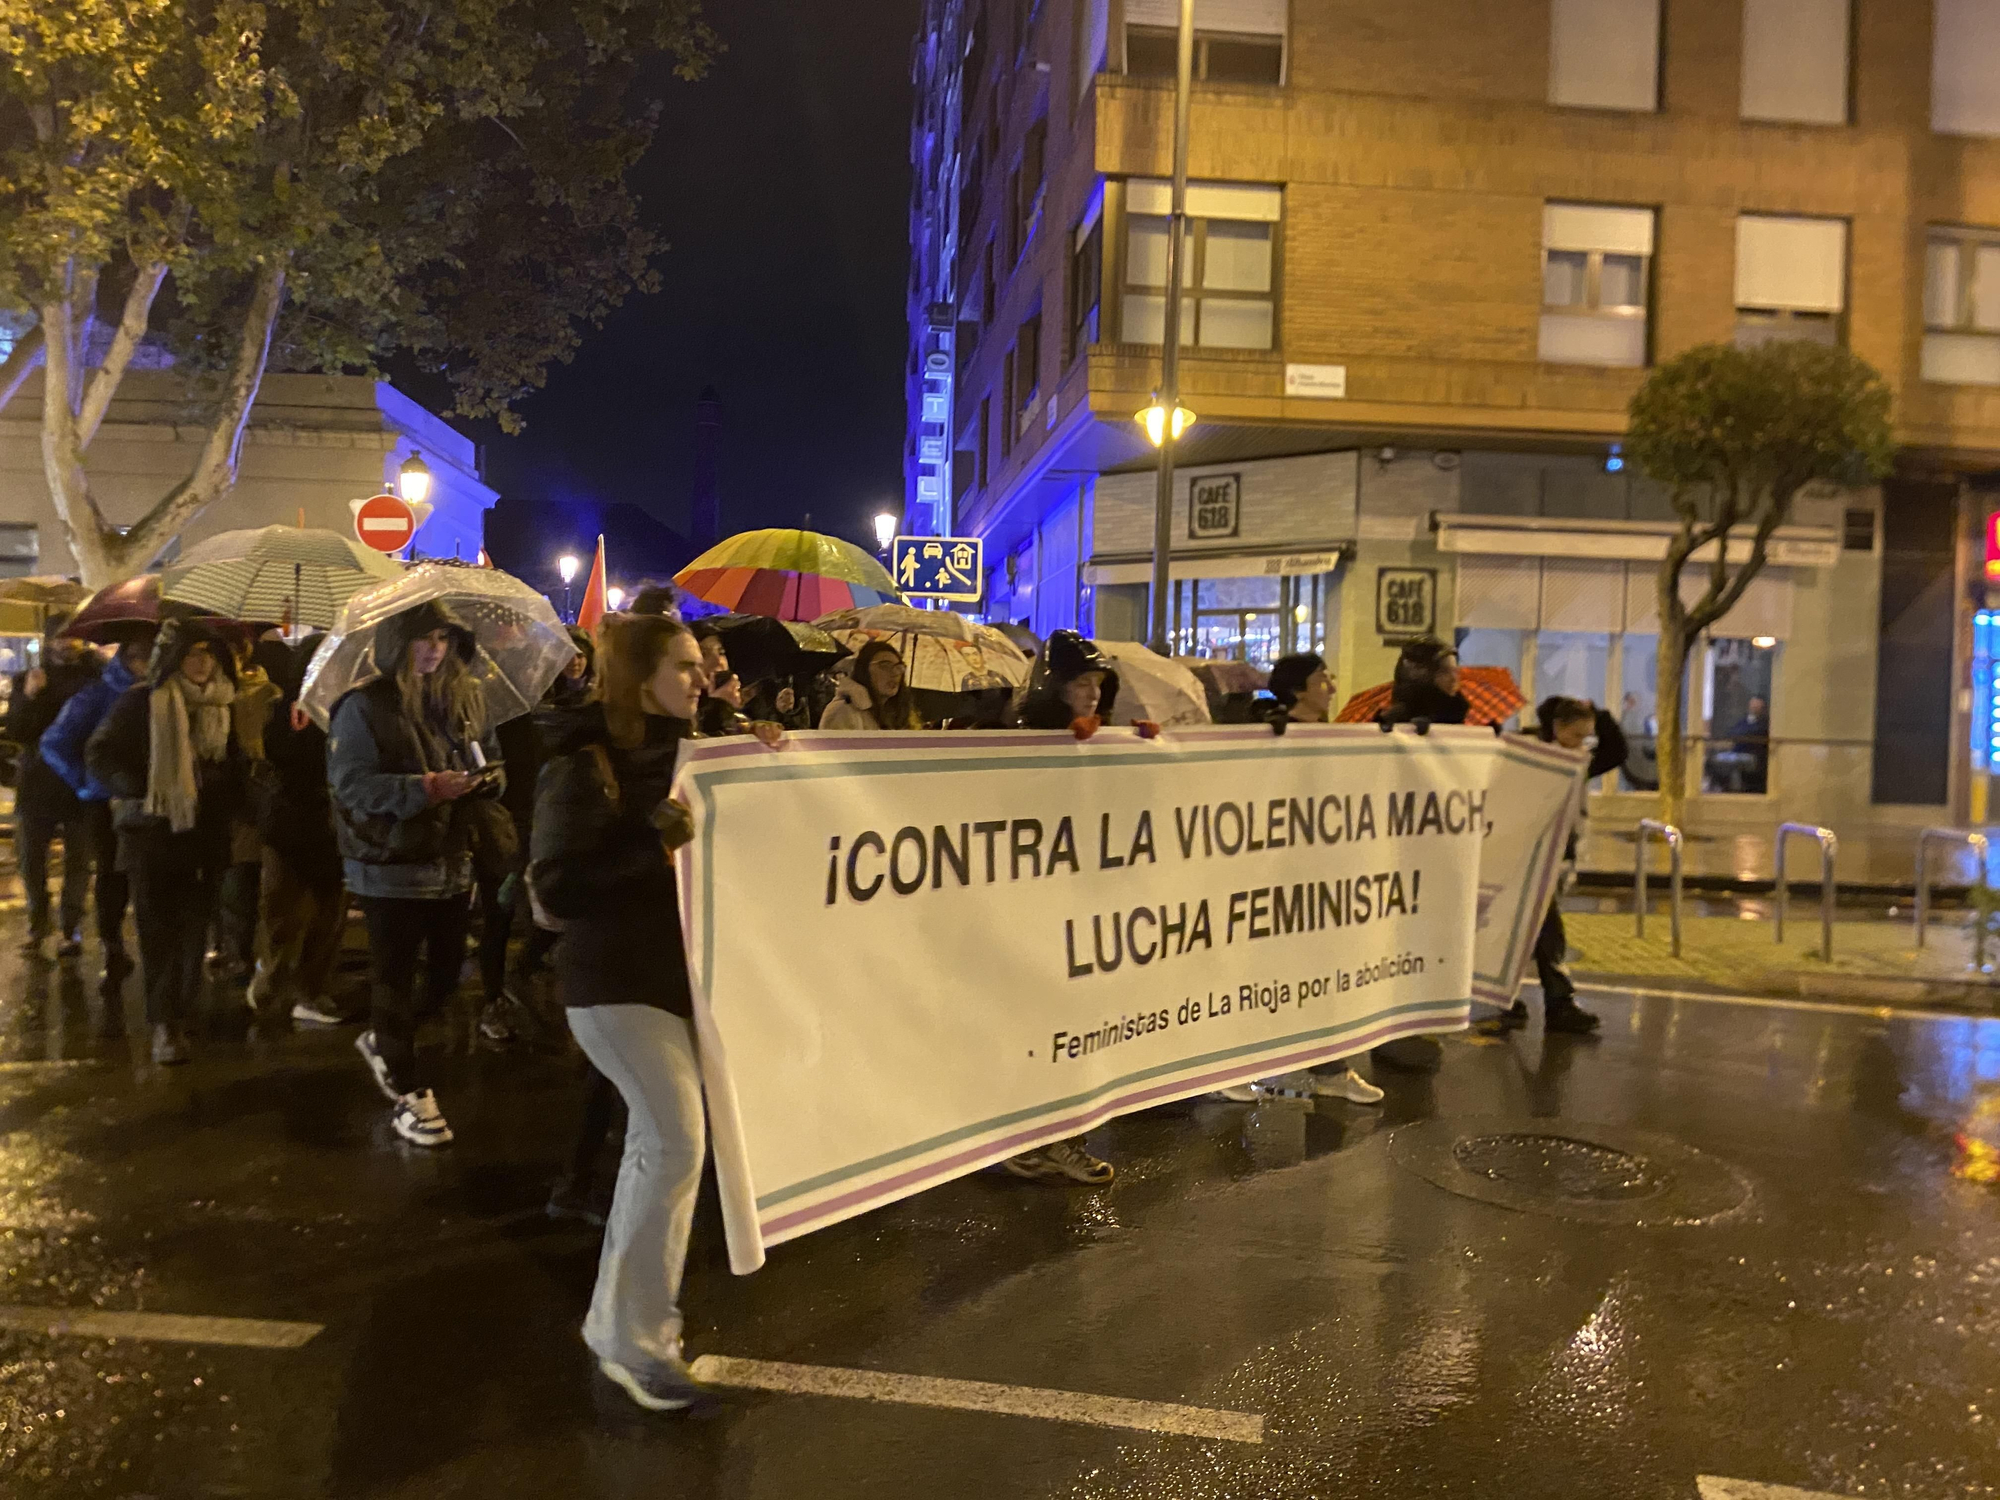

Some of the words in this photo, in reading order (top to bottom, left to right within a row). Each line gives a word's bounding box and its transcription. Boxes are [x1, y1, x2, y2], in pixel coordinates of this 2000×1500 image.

[1198, 481, 1230, 505] CAFÉ
[1198, 506, 1229, 529] 618
[1387, 600, 1424, 626] 618
[825, 815, 1080, 905] ¡CONTRA
[1100, 810, 1157, 869] LA
[1174, 793, 1377, 860] VIOLENCIA
[1065, 898, 1213, 978] LUCHA
[1226, 869, 1421, 944] FEMINISTA!
[1052, 1008, 1169, 1063] Feministas
[1177, 996, 1201, 1026] de
[1208, 991, 1232, 1018] La
[1239, 979, 1291, 1014] Rioja
[1297, 976, 1331, 1009] por
[1336, 968, 1351, 994] la
[1355, 951, 1425, 989] abolición
